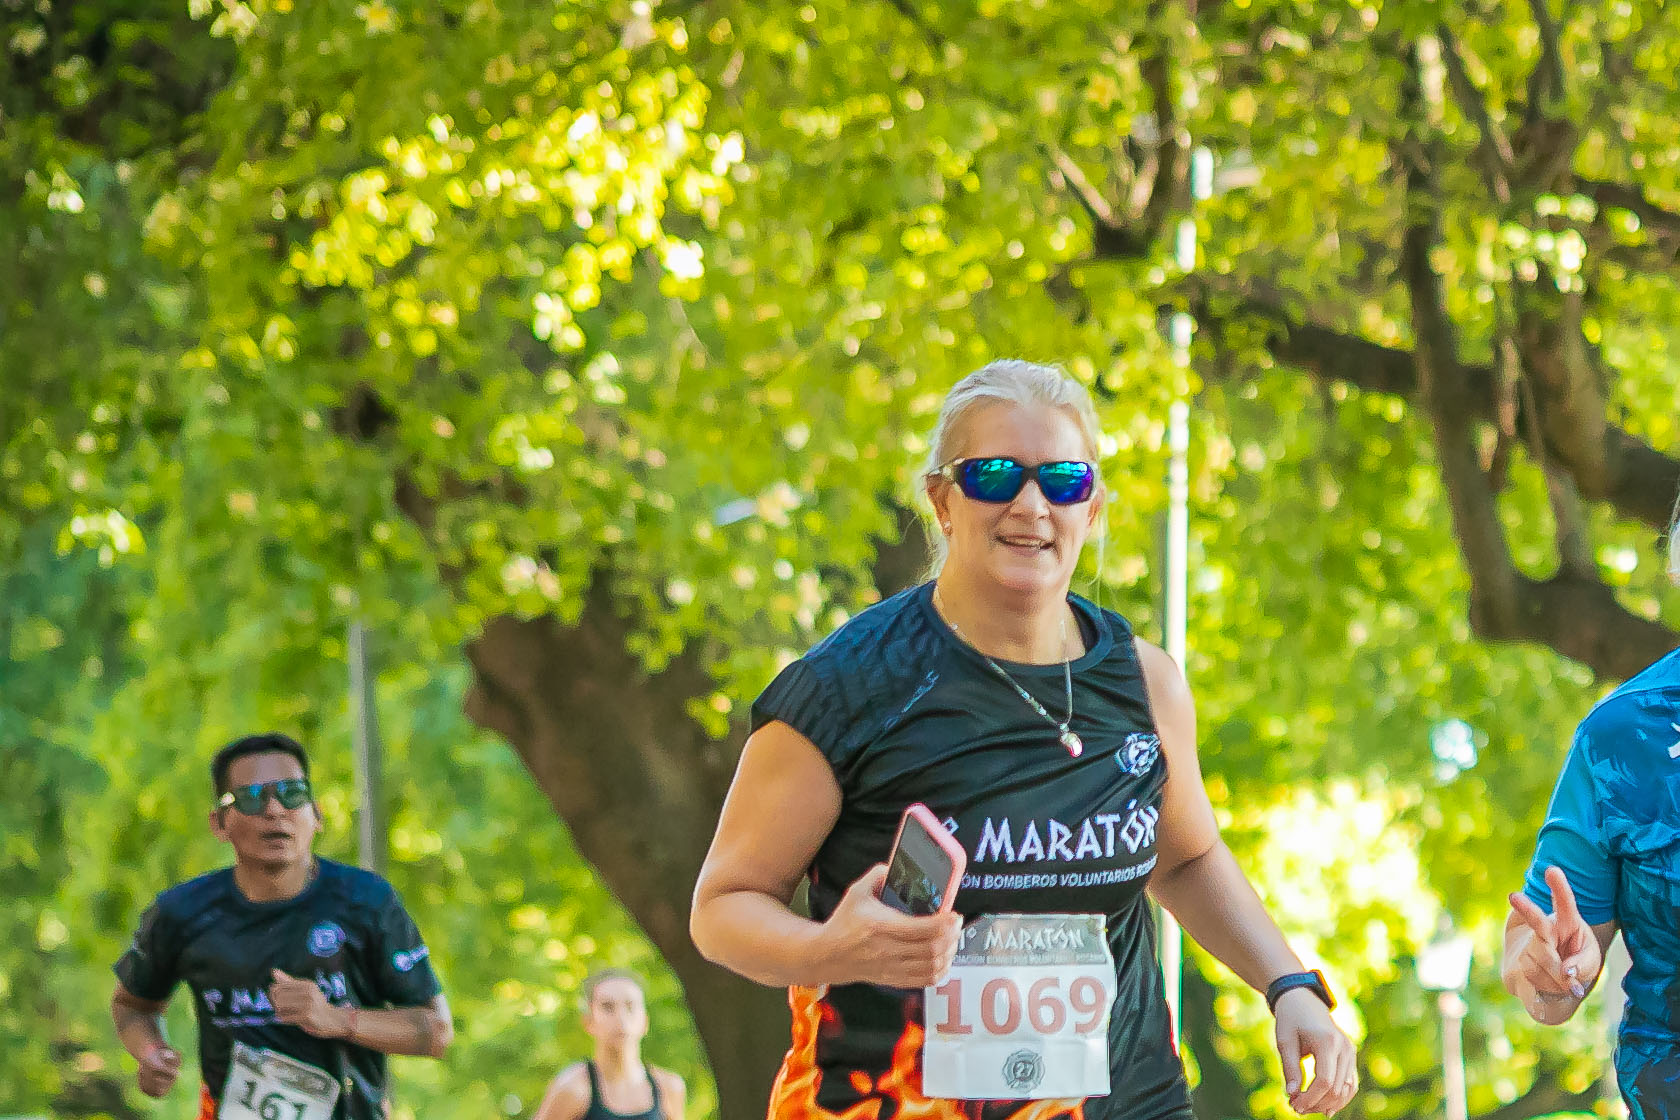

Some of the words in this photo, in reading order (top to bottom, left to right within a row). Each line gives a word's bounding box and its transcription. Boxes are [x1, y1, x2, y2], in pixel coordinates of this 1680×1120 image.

[973, 798, 1159, 864] MARATÓN
[984, 873, 1058, 890] BOMBEROS
[1060, 864, 1137, 888] VOLUNTARIOS
[984, 920, 1085, 951] MARATÓN
[935, 976, 1108, 1036] 1069
